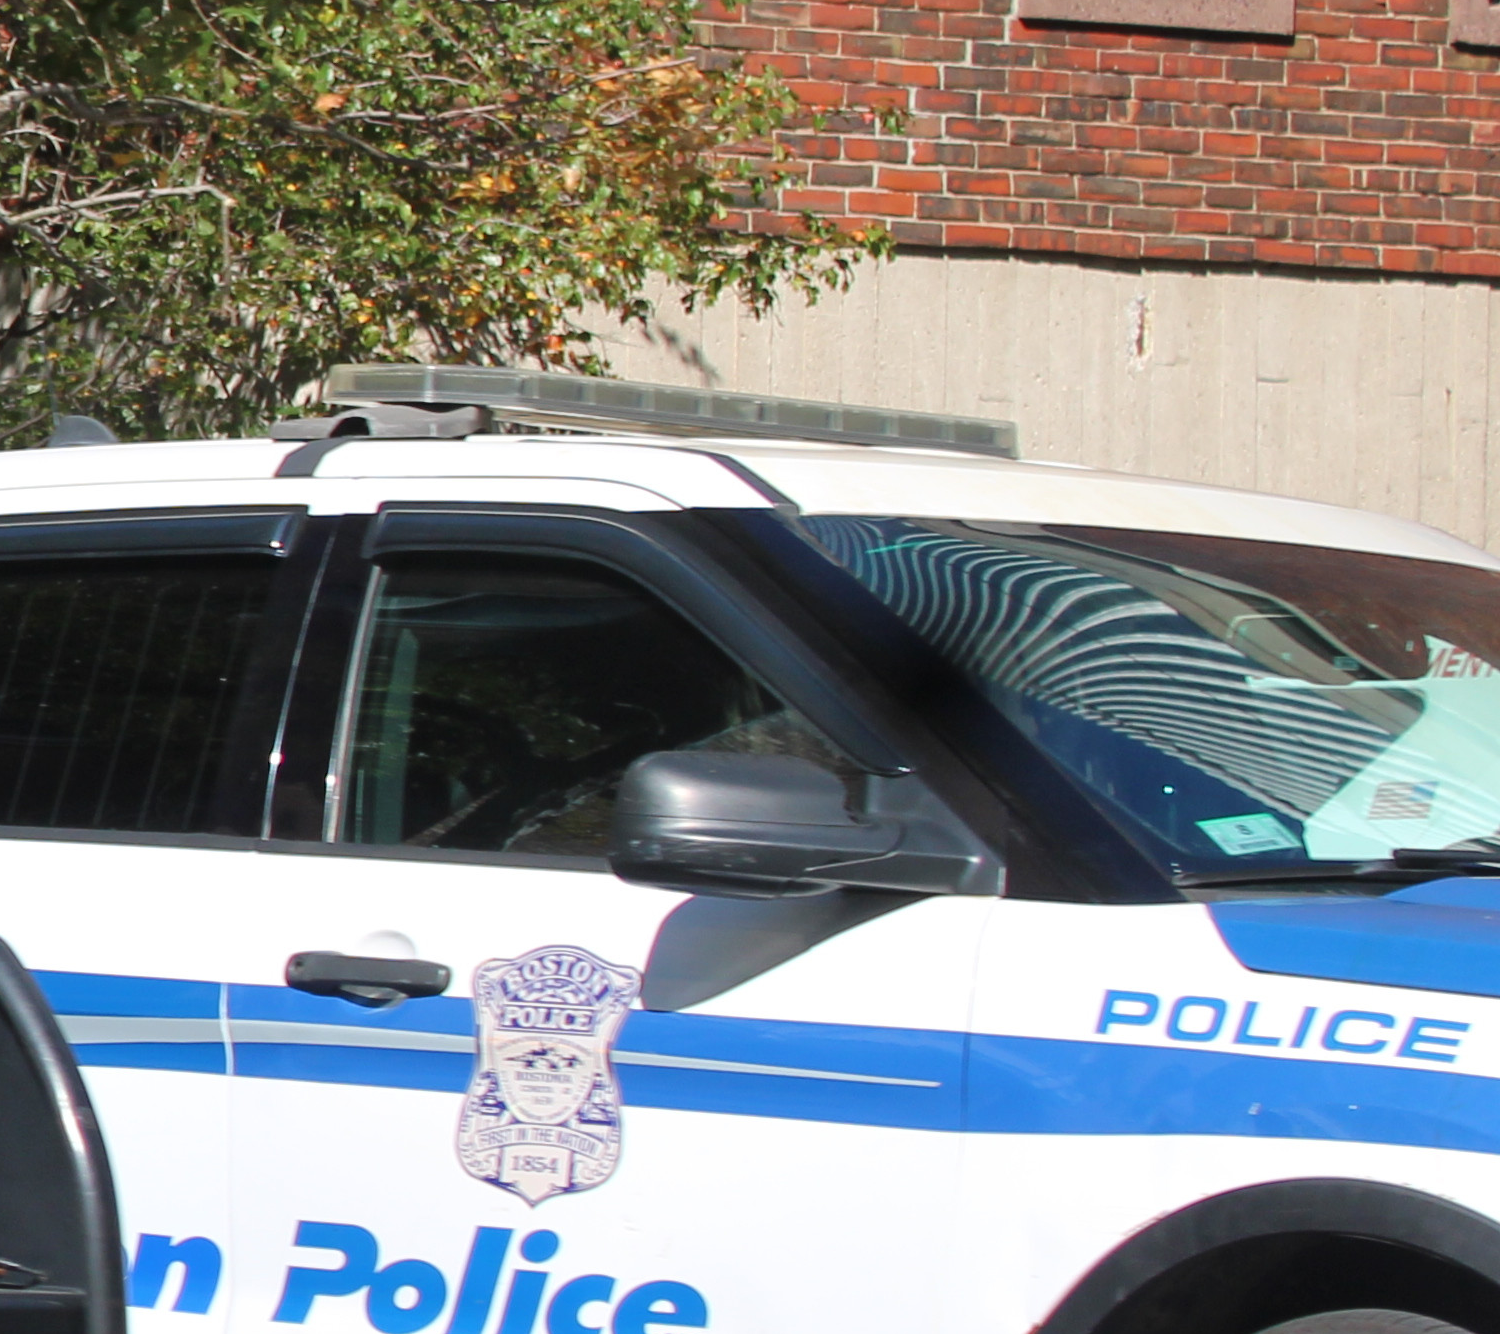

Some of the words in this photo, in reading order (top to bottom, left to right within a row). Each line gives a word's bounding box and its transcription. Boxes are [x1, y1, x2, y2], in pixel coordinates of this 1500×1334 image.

[502, 954, 611, 1001] BOSTON
[504, 1006, 594, 1031] POLICE
[1094, 989, 1473, 1063] POLICE
[510, 1154, 560, 1174] 1854
